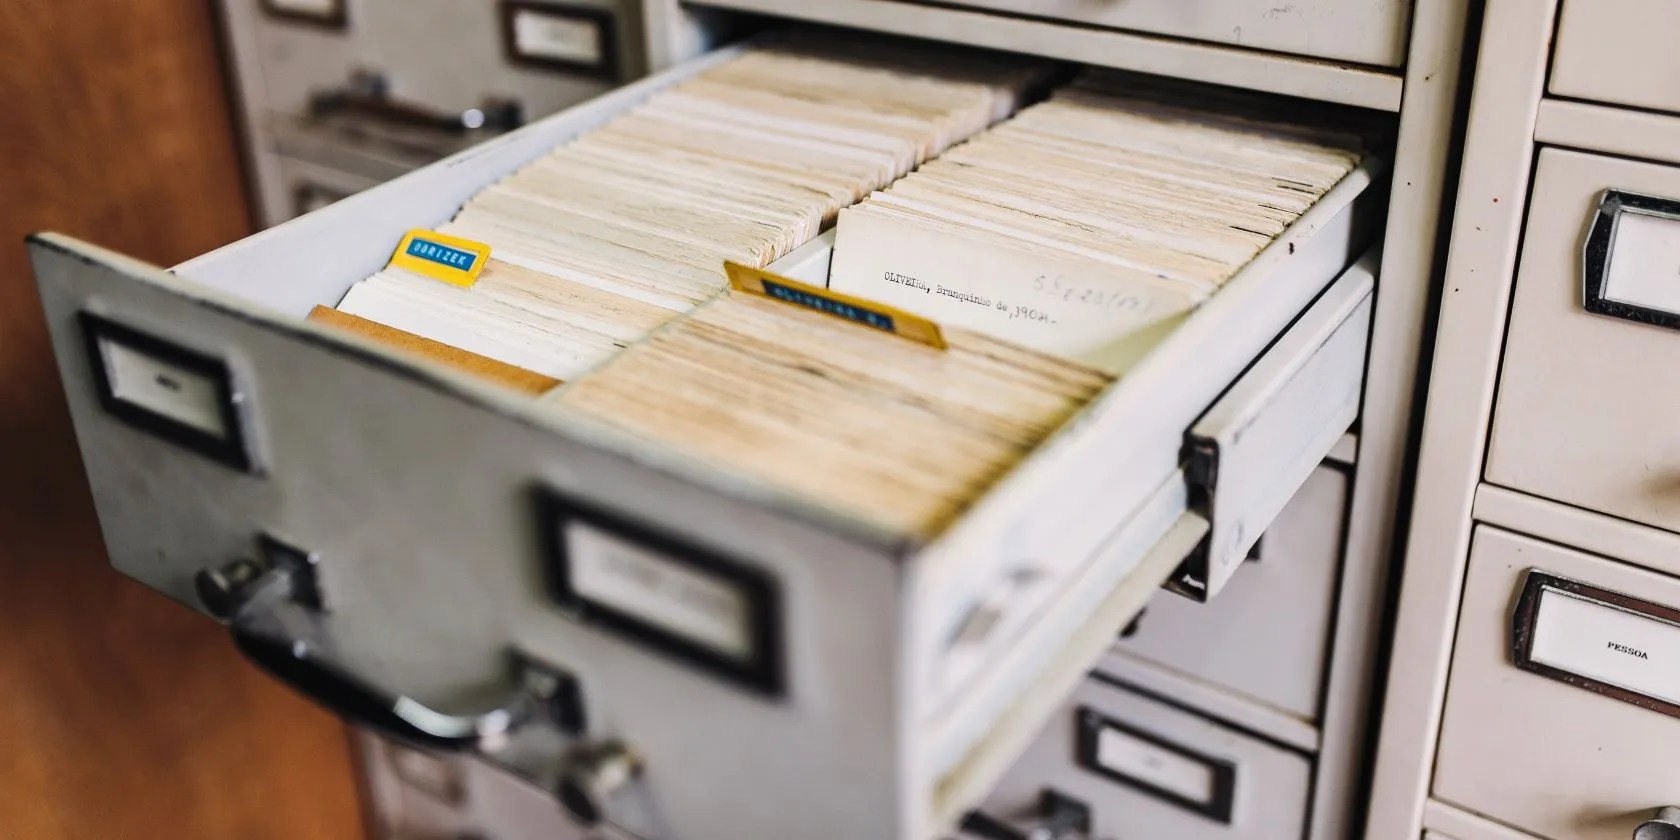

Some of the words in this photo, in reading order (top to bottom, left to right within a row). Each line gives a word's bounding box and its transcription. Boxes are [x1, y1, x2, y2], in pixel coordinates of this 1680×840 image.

[884, 271, 931, 294] OLIVEIRA,
[936, 284, 992, 307] Branquinho
[1607, 641, 1648, 660] PESSOA
